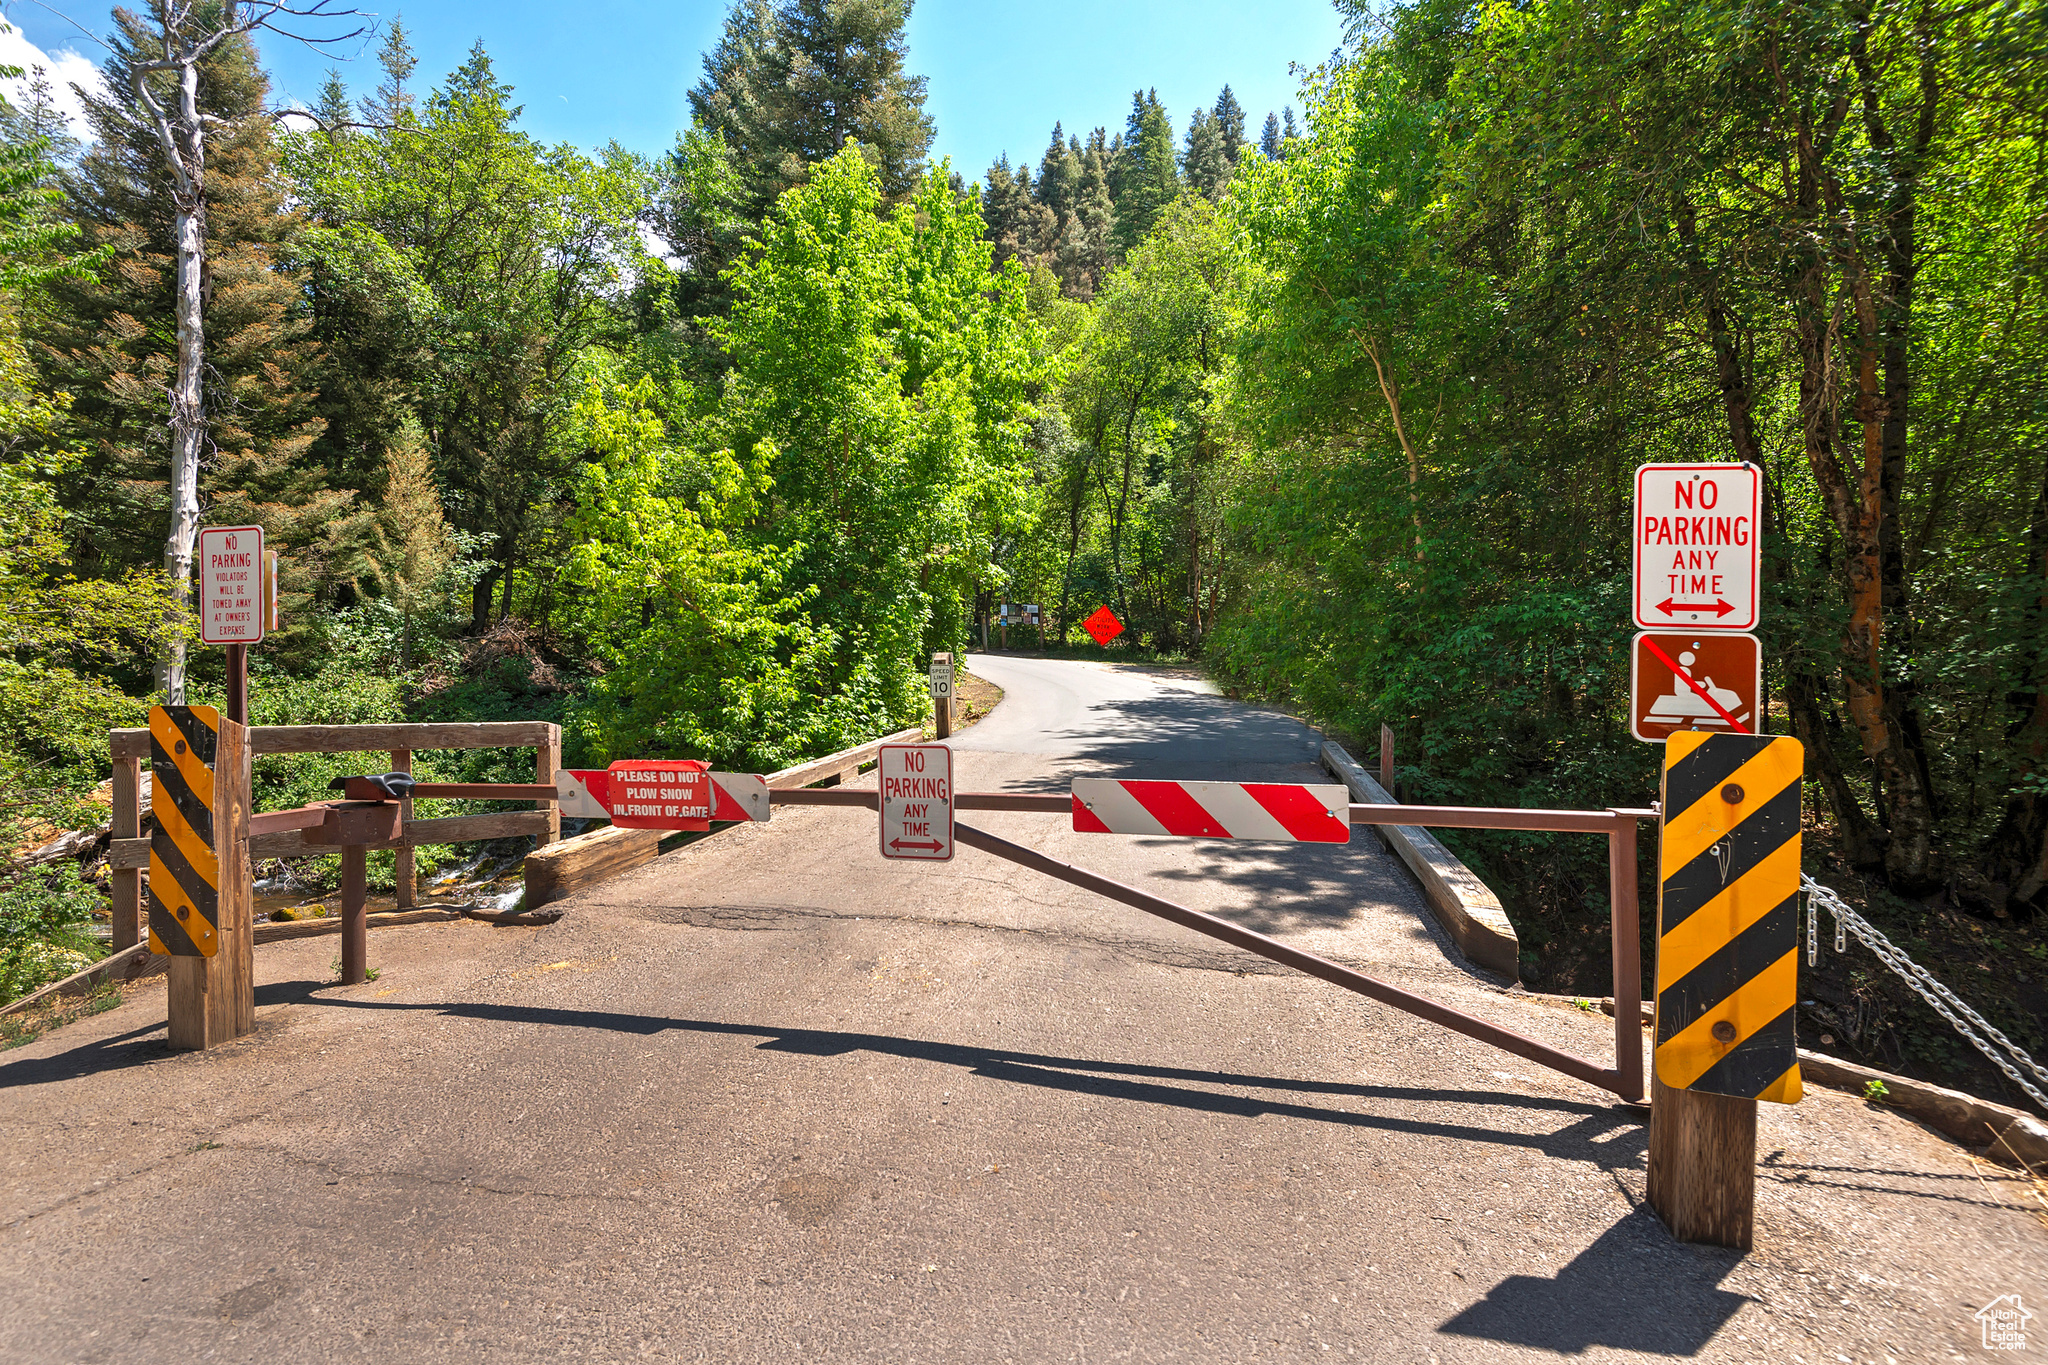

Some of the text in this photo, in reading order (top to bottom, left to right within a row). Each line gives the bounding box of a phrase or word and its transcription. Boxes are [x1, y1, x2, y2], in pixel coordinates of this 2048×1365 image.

[1674, 480, 1718, 509] NO
[1644, 516, 1749, 546] PARKING
[226, 536, 237, 550] NO
[212, 553, 251, 568] PARKING
[1672, 550, 1719, 570] ANY
[216, 572, 247, 582] VIOLATORS
[1668, 574, 1723, 594] TIME
[220, 585, 244, 595] WILL BE
[212, 598, 251, 608] TOWED AWAY
[215, 612, 250, 622] AT OWNER'S
[220, 626, 245, 635] EXPENSE
[934, 682, 948, 692] 10
[905, 752, 924, 772] NO
[616, 771, 699, 783] PLEASE DO NOT
[626, 788, 692, 800] PLOW SNOW
[885, 778, 946, 799] PARKING
[613, 804, 708, 818] IN FRONT OF GATE
[904, 804, 928, 818] ANY
[902, 822, 930, 836] TIME
